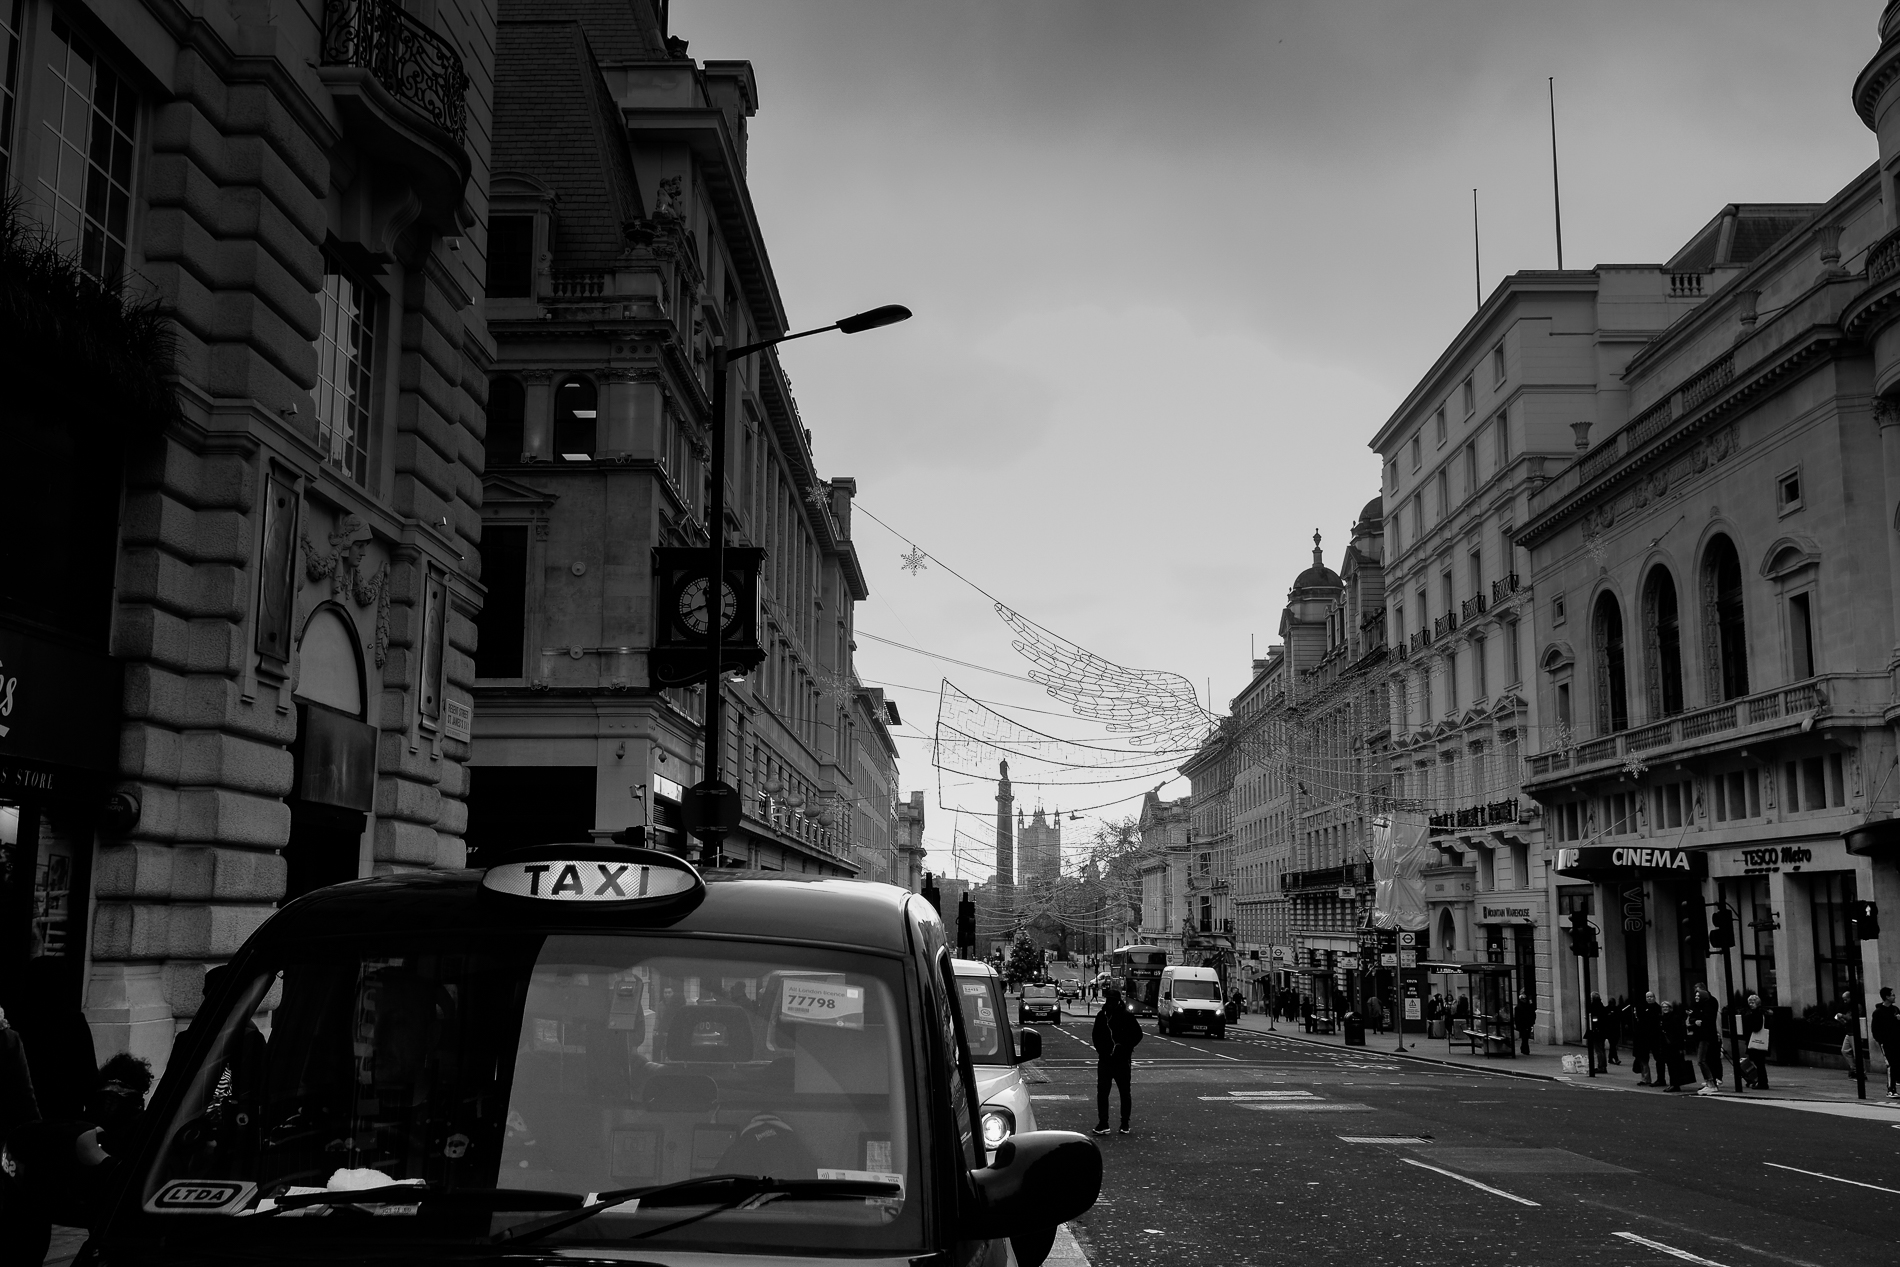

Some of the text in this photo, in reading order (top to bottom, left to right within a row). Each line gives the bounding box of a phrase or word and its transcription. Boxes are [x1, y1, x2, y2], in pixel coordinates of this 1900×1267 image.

[15, 768, 55, 790] STORE
[1612, 847, 1691, 871] CINEMA
[1741, 846, 1812, 867] TESCO Metro
[524, 863, 651, 897] TAXI
[1460, 882, 1471, 892] 15
[1487, 907, 1530, 918] MOUNTAIN WAREHOUSE
[798, 987, 822, 995] London
[823, 990, 846, 998] licence
[788, 994, 836, 1010] 77798
[168, 1188, 226, 1201] LTDA
